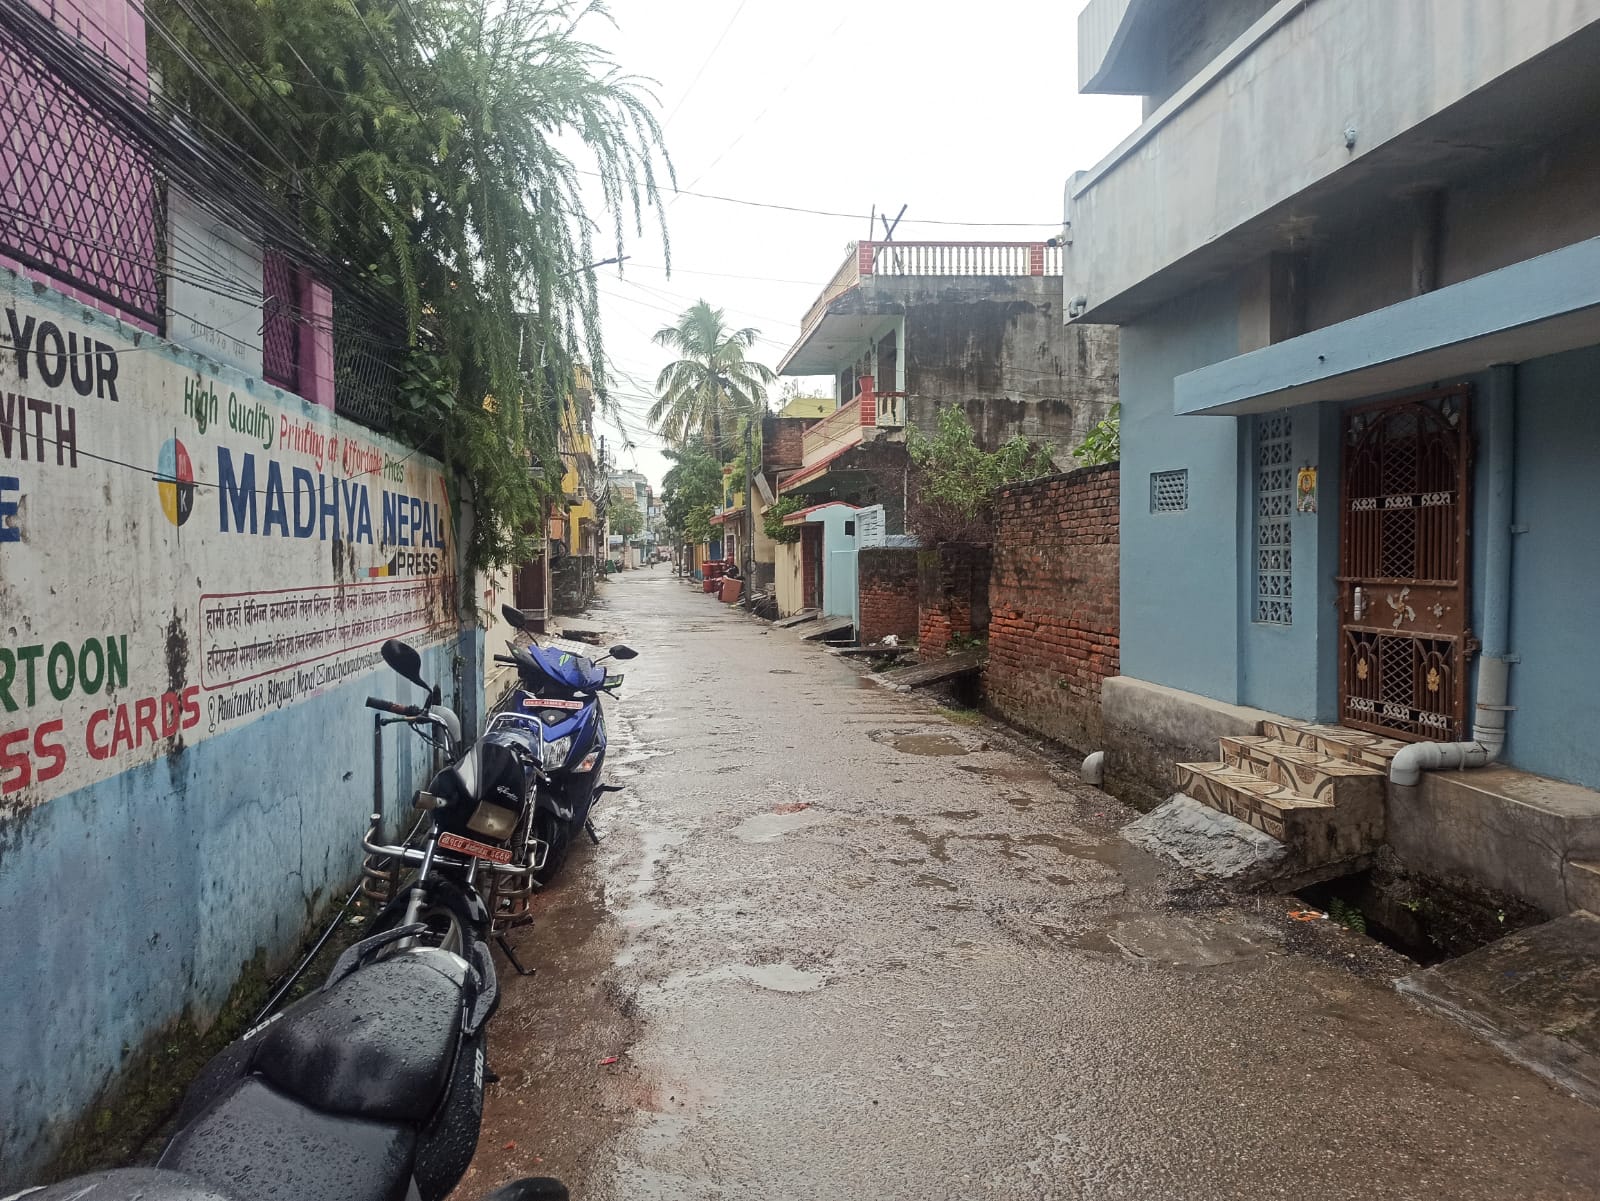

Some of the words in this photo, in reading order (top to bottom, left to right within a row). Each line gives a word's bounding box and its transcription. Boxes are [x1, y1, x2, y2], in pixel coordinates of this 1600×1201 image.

[5, 308, 119, 402] YOUR
[184, 376, 218, 435] High
[228, 391, 274, 450] Quality
[279, 414, 325, 472] Printing
[327, 432, 339, 462] at
[383, 452, 405, 484] Prices
[180, 489, 188, 513] K
[217, 445, 373, 545] MADHYA
[382, 490, 445, 548] NEPAL
[397, 551, 438, 577] PRESS
[206, 602, 225, 638] हामी
[0, 634, 128, 713] RTOON
[0, 718, 66, 795] SS
[86, 685, 200, 760] CARDS
[473, 1047, 484, 1089] 200
